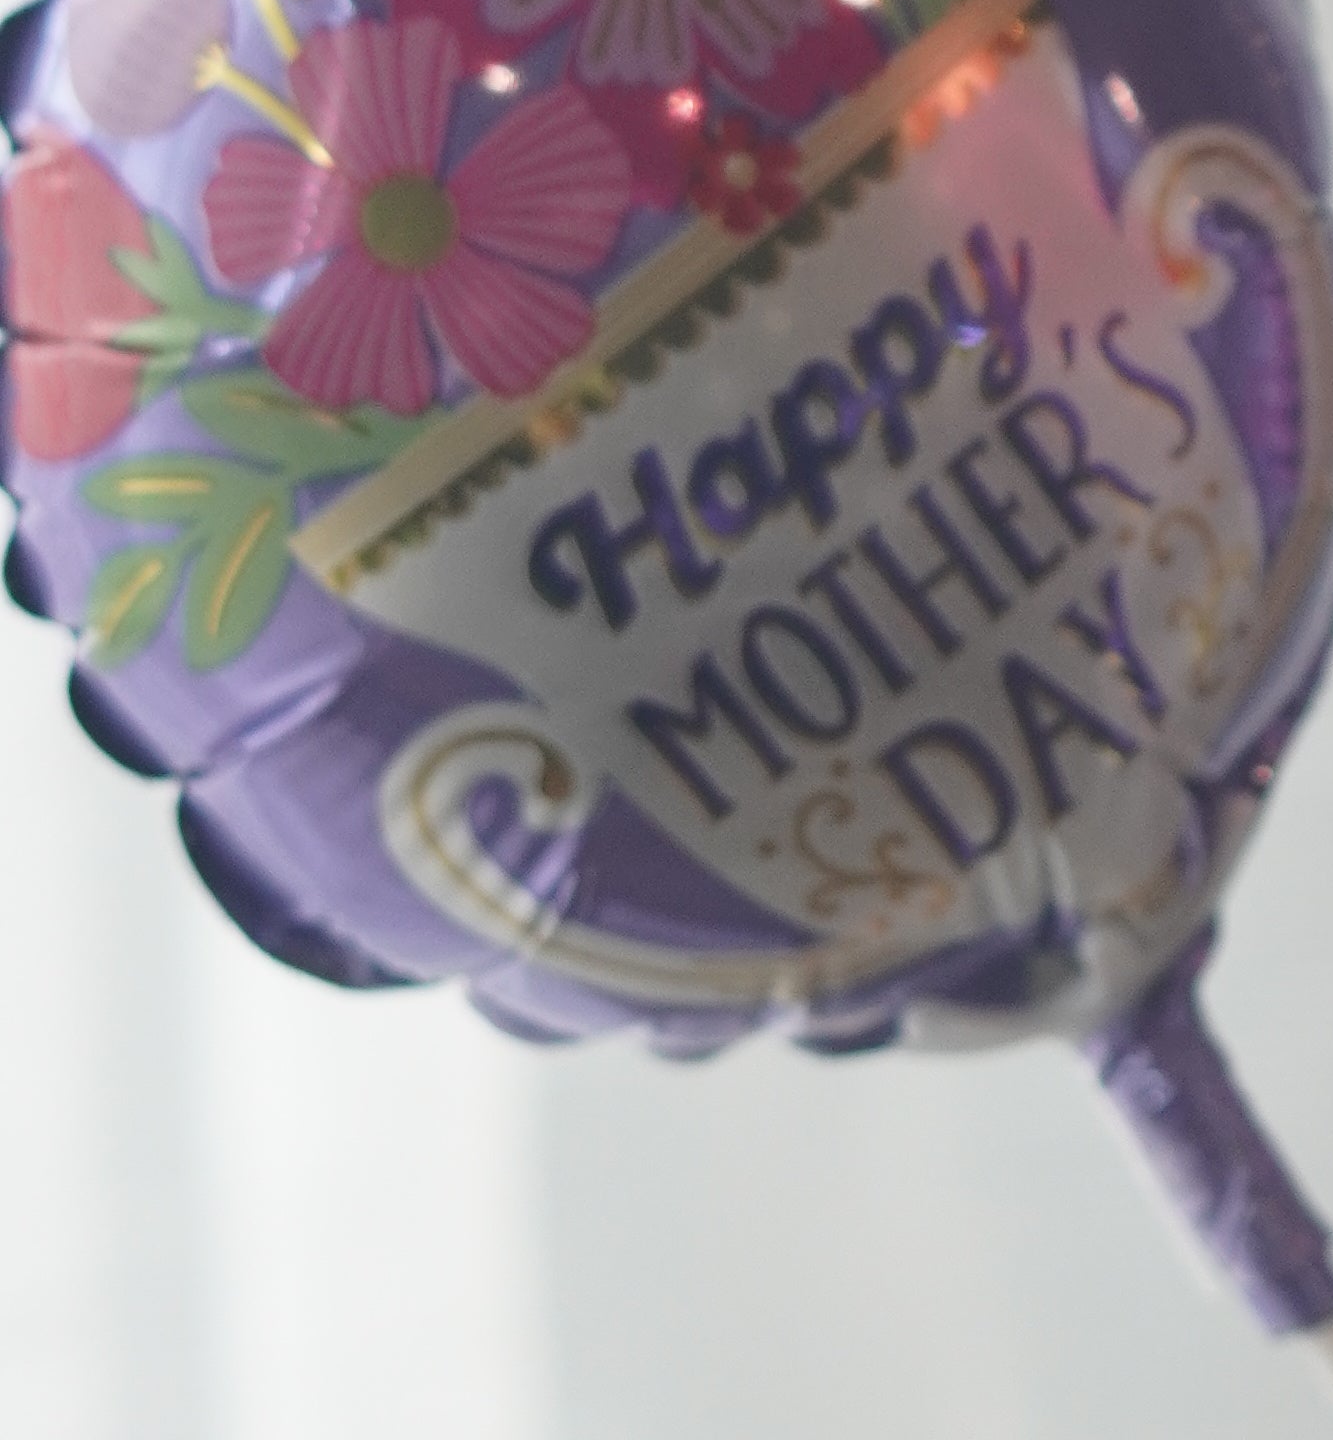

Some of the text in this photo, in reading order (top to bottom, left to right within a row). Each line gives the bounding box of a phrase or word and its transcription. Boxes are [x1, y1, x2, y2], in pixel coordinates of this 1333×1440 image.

[527, 222, 1032, 632] Happy
[624, 310, 1197, 822] MOTHER'S
[879, 566, 1167, 872] DAY
